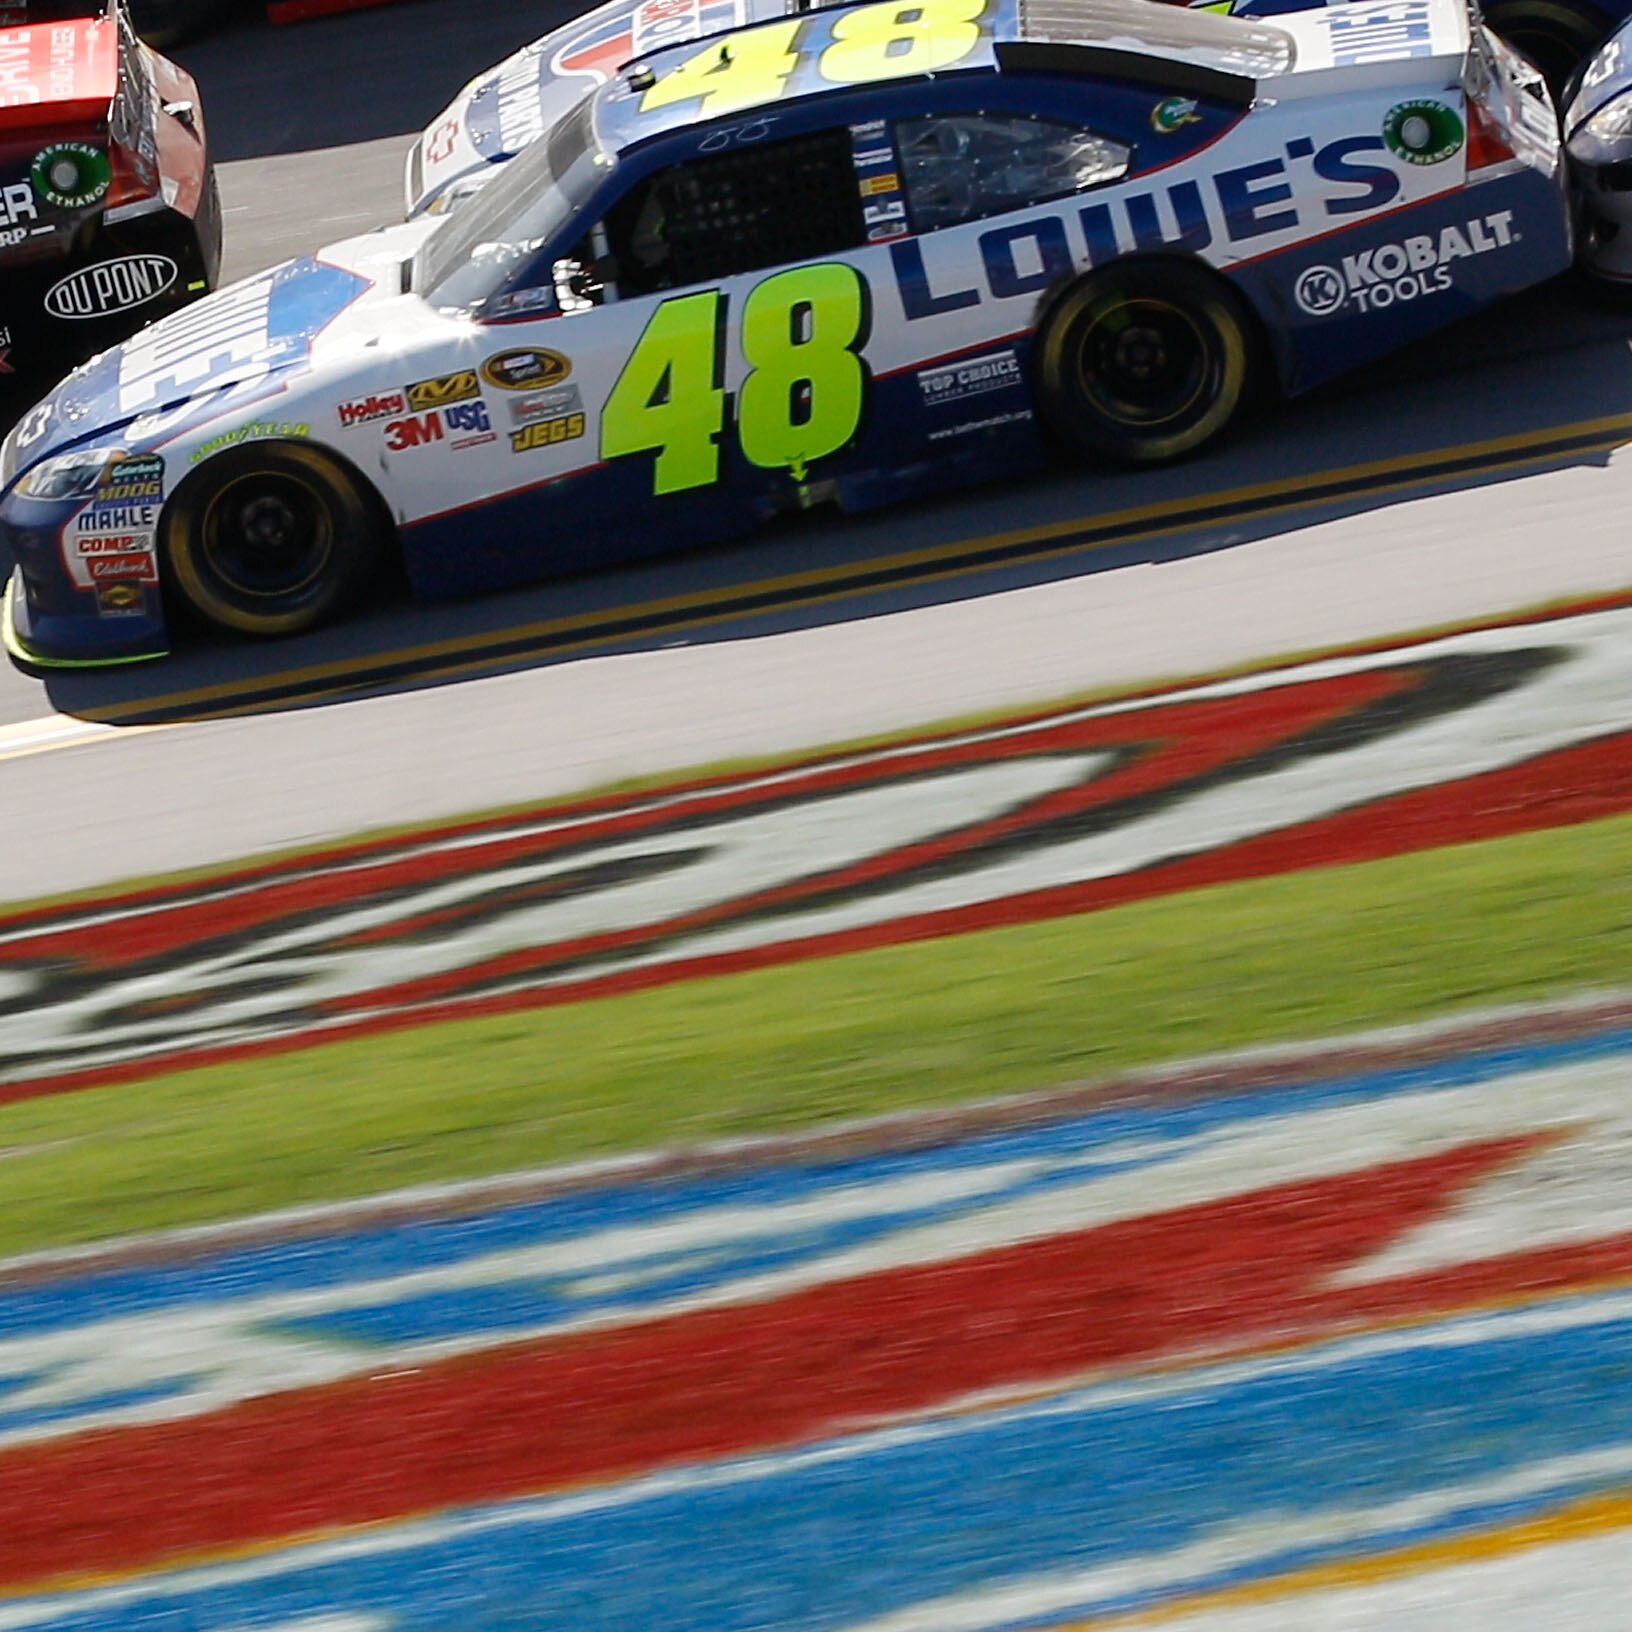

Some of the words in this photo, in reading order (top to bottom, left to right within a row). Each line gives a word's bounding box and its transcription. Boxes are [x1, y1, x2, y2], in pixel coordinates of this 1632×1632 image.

[1382, 98, 1447, 133] AMERICAN
[31, 141, 99, 172] AMERICAN
[1395, 136, 1464, 166] ETHANOL
[45, 179, 111, 208] ETHANOL
[888, 134, 1402, 322] LOWE'S
[1343, 210, 1514, 290] KOBALT
[1348, 265, 1453, 313] TOOLS
[599, 261, 865, 497] 48
[919, 374, 954, 394] TOP
[956, 357, 1020, 389] CHOICE
[336, 393, 405, 422] Holley
[444, 400, 492, 433] USG
[383, 410, 445, 451] 3M
[508, 411, 586, 453] JEGS
[97, 481, 160, 500] MOOG
[77, 506, 153, 531] MAHLE
[78, 535, 136, 553] COMP
